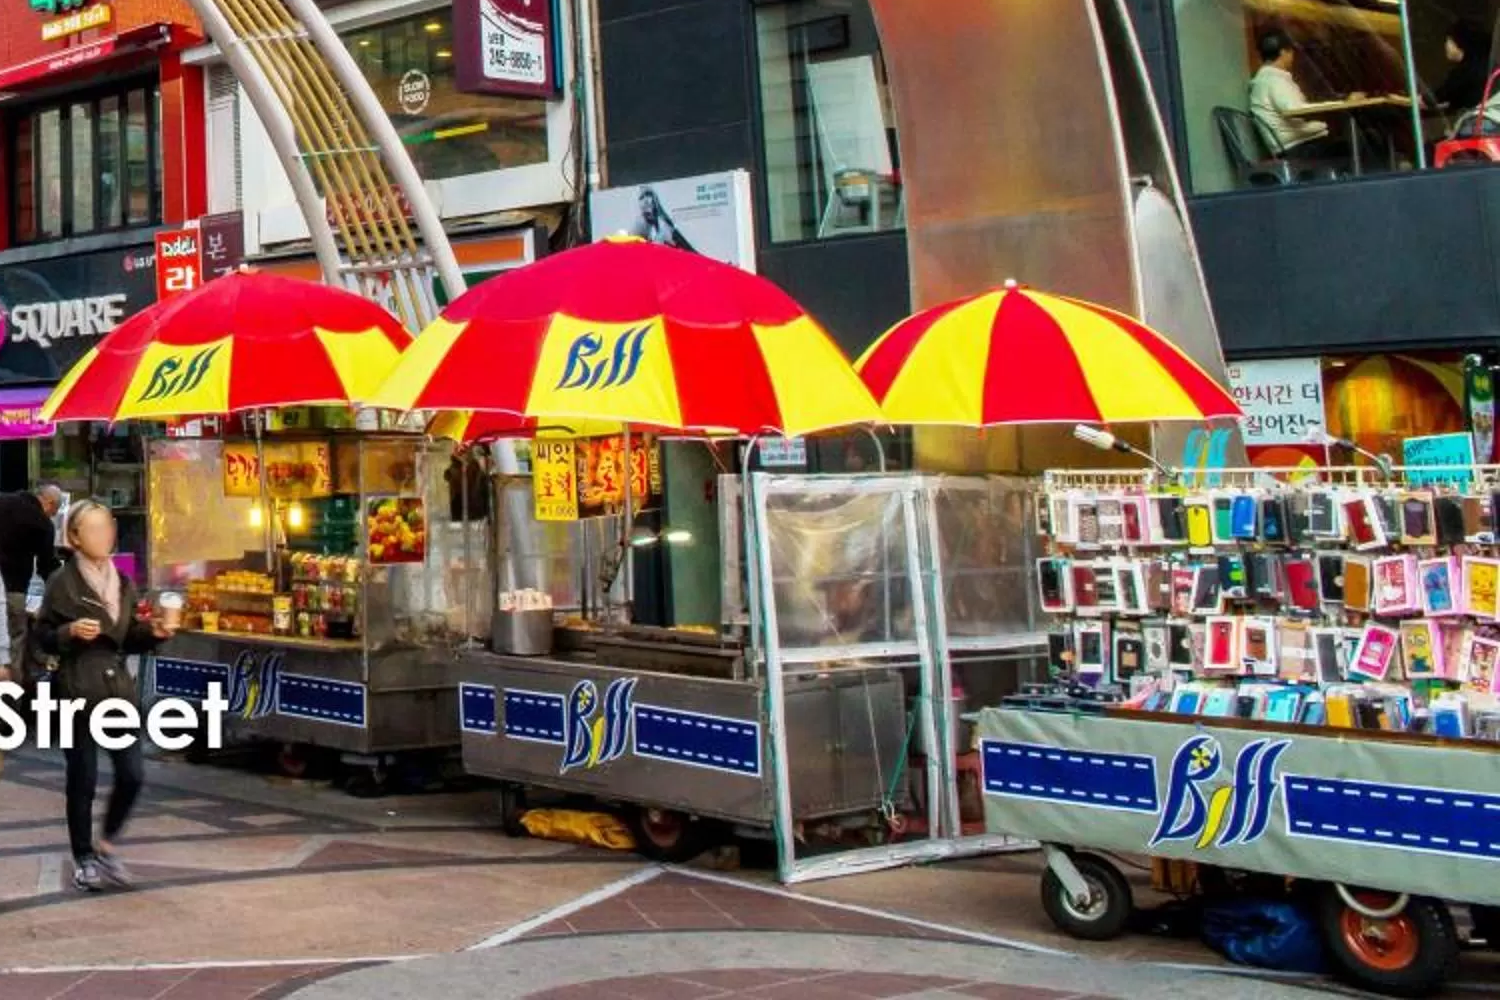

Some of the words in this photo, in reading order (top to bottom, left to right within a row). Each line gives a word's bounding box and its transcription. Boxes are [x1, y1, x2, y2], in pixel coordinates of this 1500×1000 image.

[165, 265, 196, 292] 라
[11, 294, 128, 348] SQUARE
[1301, 383, 1320, 404] 더
[536, 443, 570, 465] 씨앗
